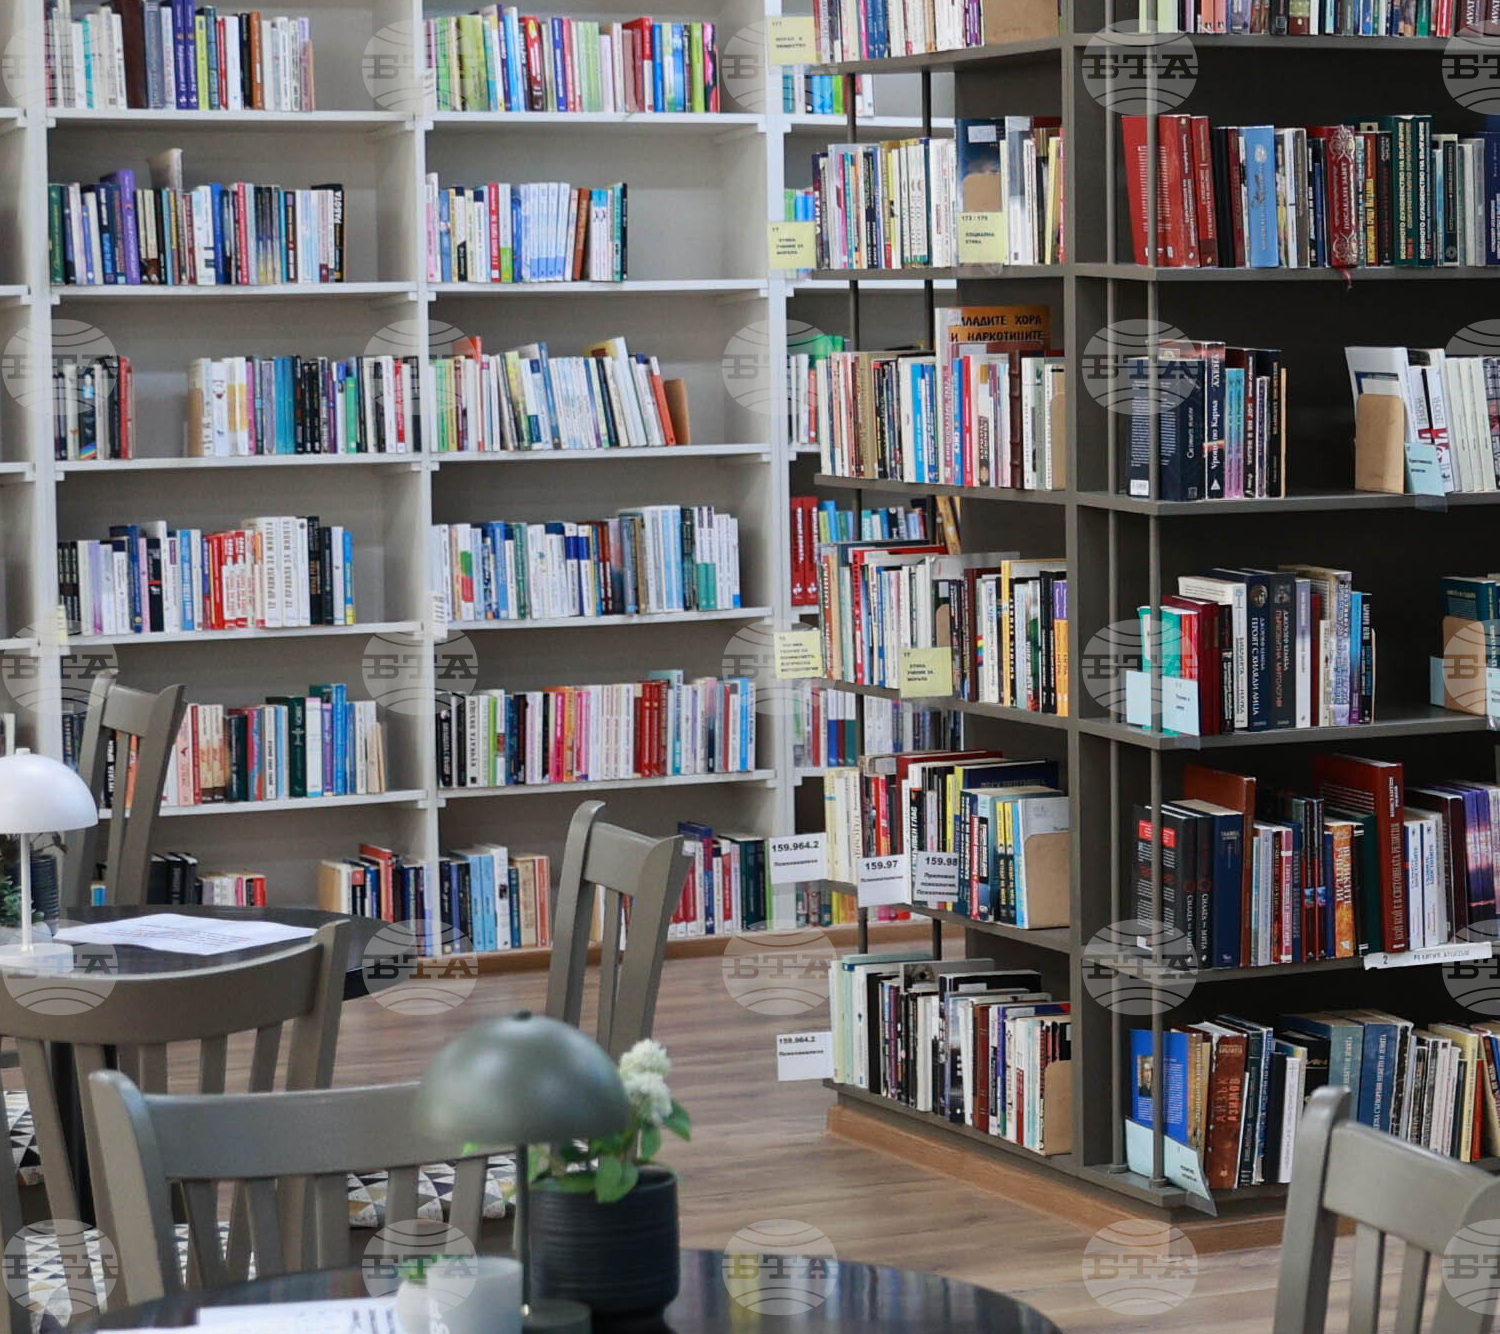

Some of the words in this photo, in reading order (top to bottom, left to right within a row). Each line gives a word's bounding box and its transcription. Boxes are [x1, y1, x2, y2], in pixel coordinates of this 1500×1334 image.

[771, 840, 820, 853] 159.964.2
[864, 859, 899, 871] 159.97
[778, 1035, 817, 1045] 159.964.2
